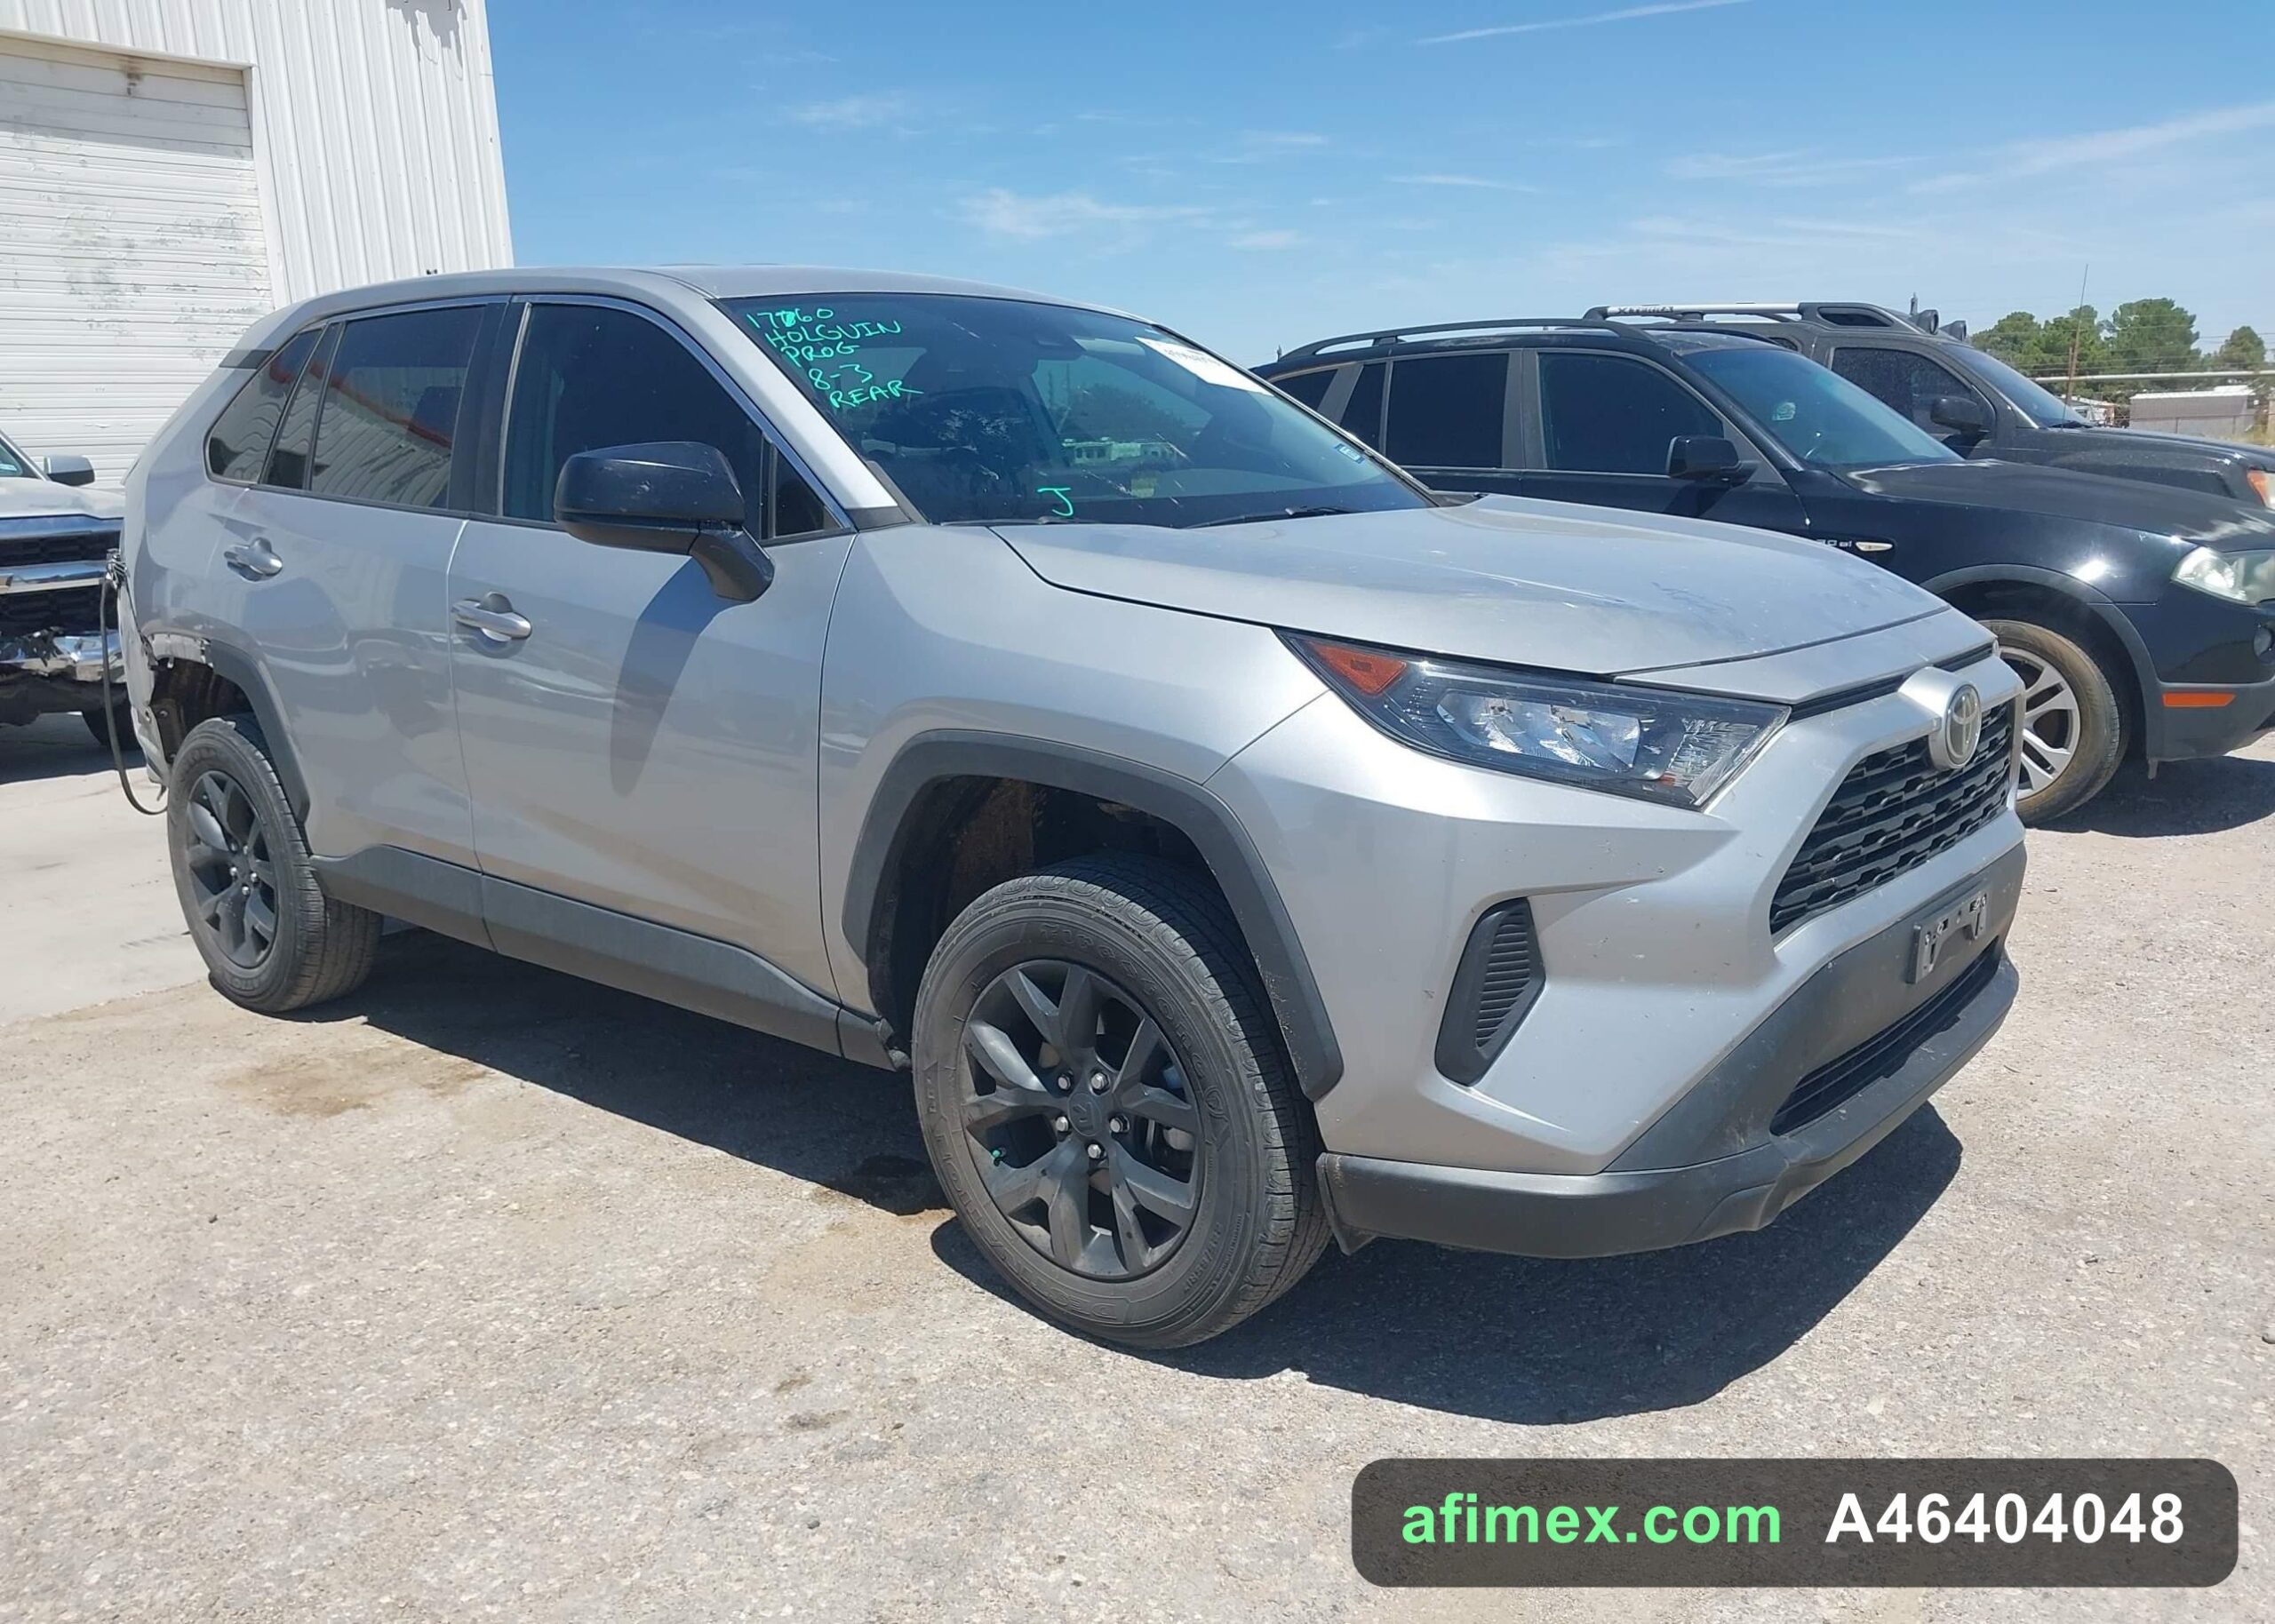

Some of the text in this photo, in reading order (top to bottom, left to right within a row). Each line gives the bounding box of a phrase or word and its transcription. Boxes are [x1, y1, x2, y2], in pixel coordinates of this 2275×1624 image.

[765, 321, 901, 347] HOLGUIN
[780, 341, 859, 368] PROG
[829, 379, 923, 408] REAR
[1037, 487, 1074, 516] J
